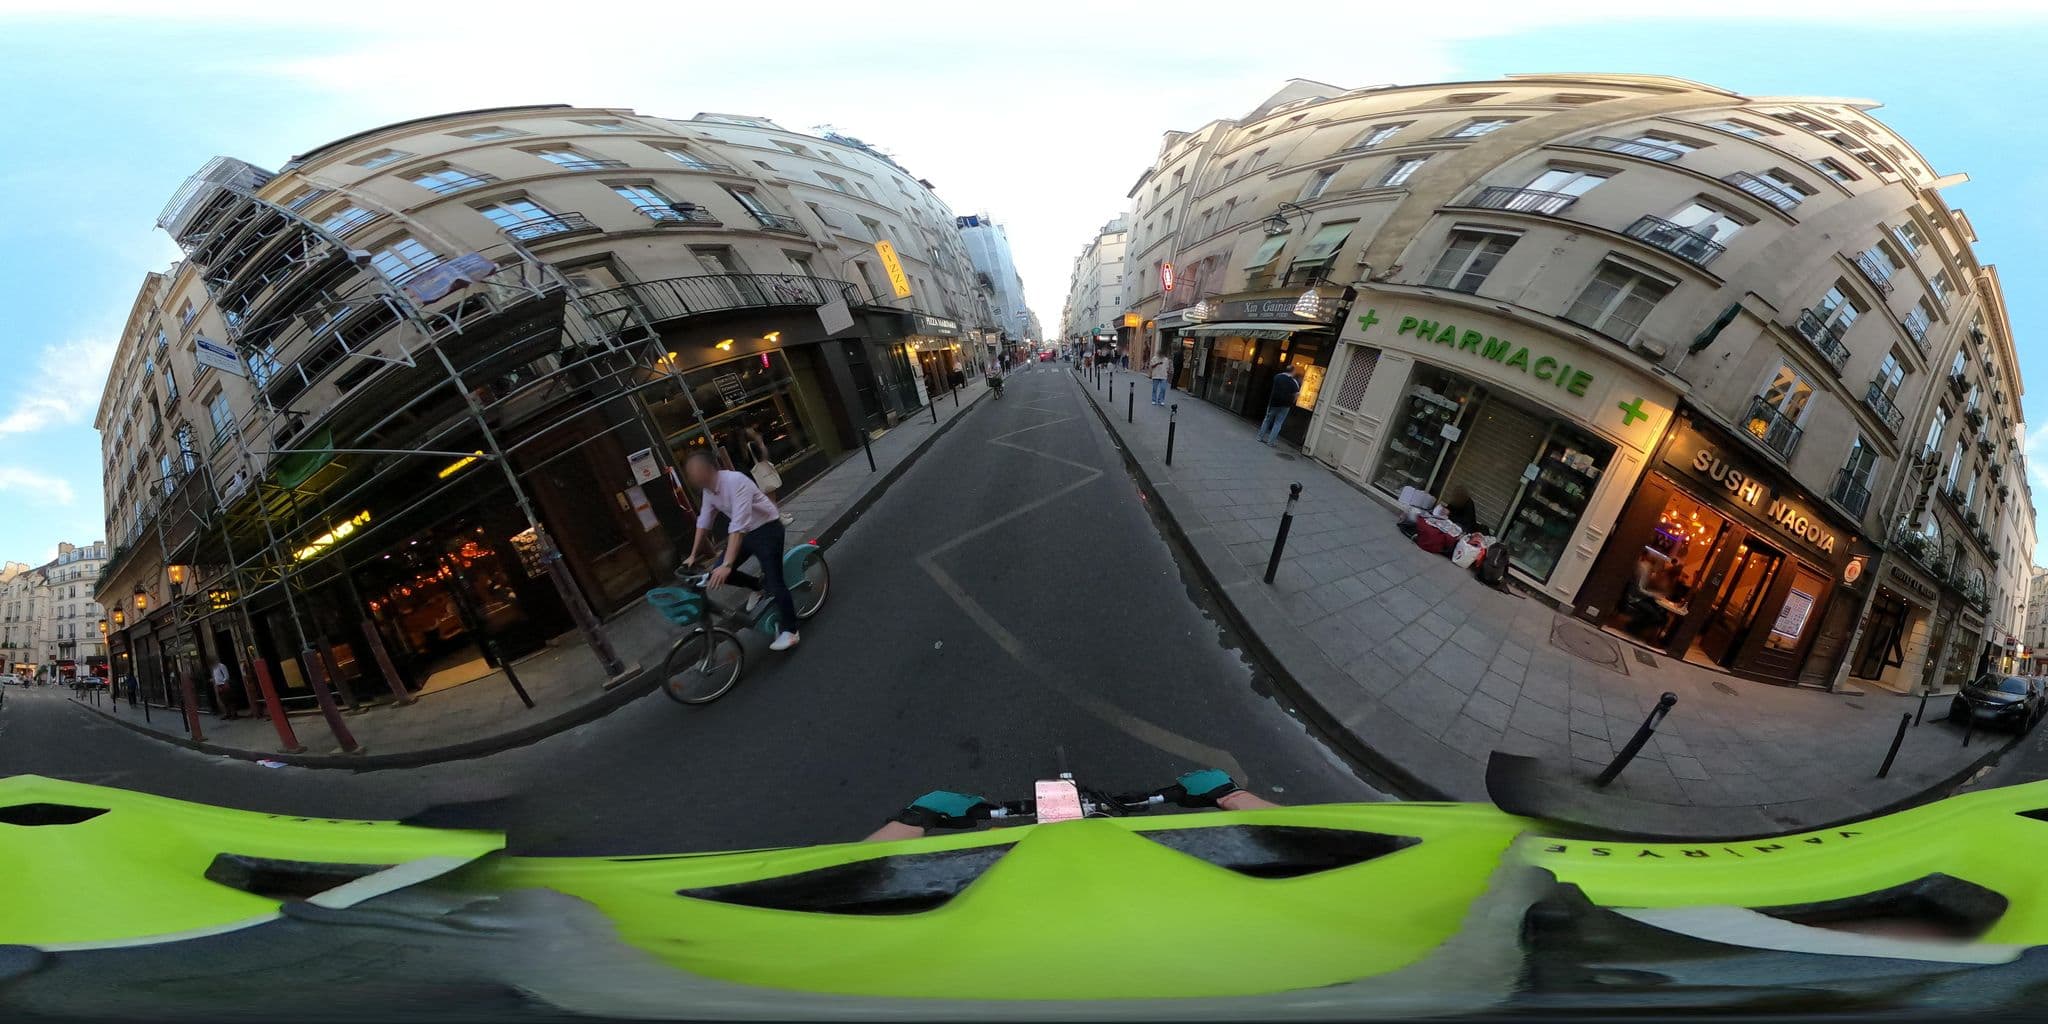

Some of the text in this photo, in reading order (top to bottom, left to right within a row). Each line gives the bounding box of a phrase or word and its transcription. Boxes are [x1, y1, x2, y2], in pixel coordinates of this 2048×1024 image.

[881, 244, 907, 295] PIZZA
[1397, 316, 1594, 397] PHARMACIE
[1693, 449, 1835, 554] SUSHI NAGOYA
